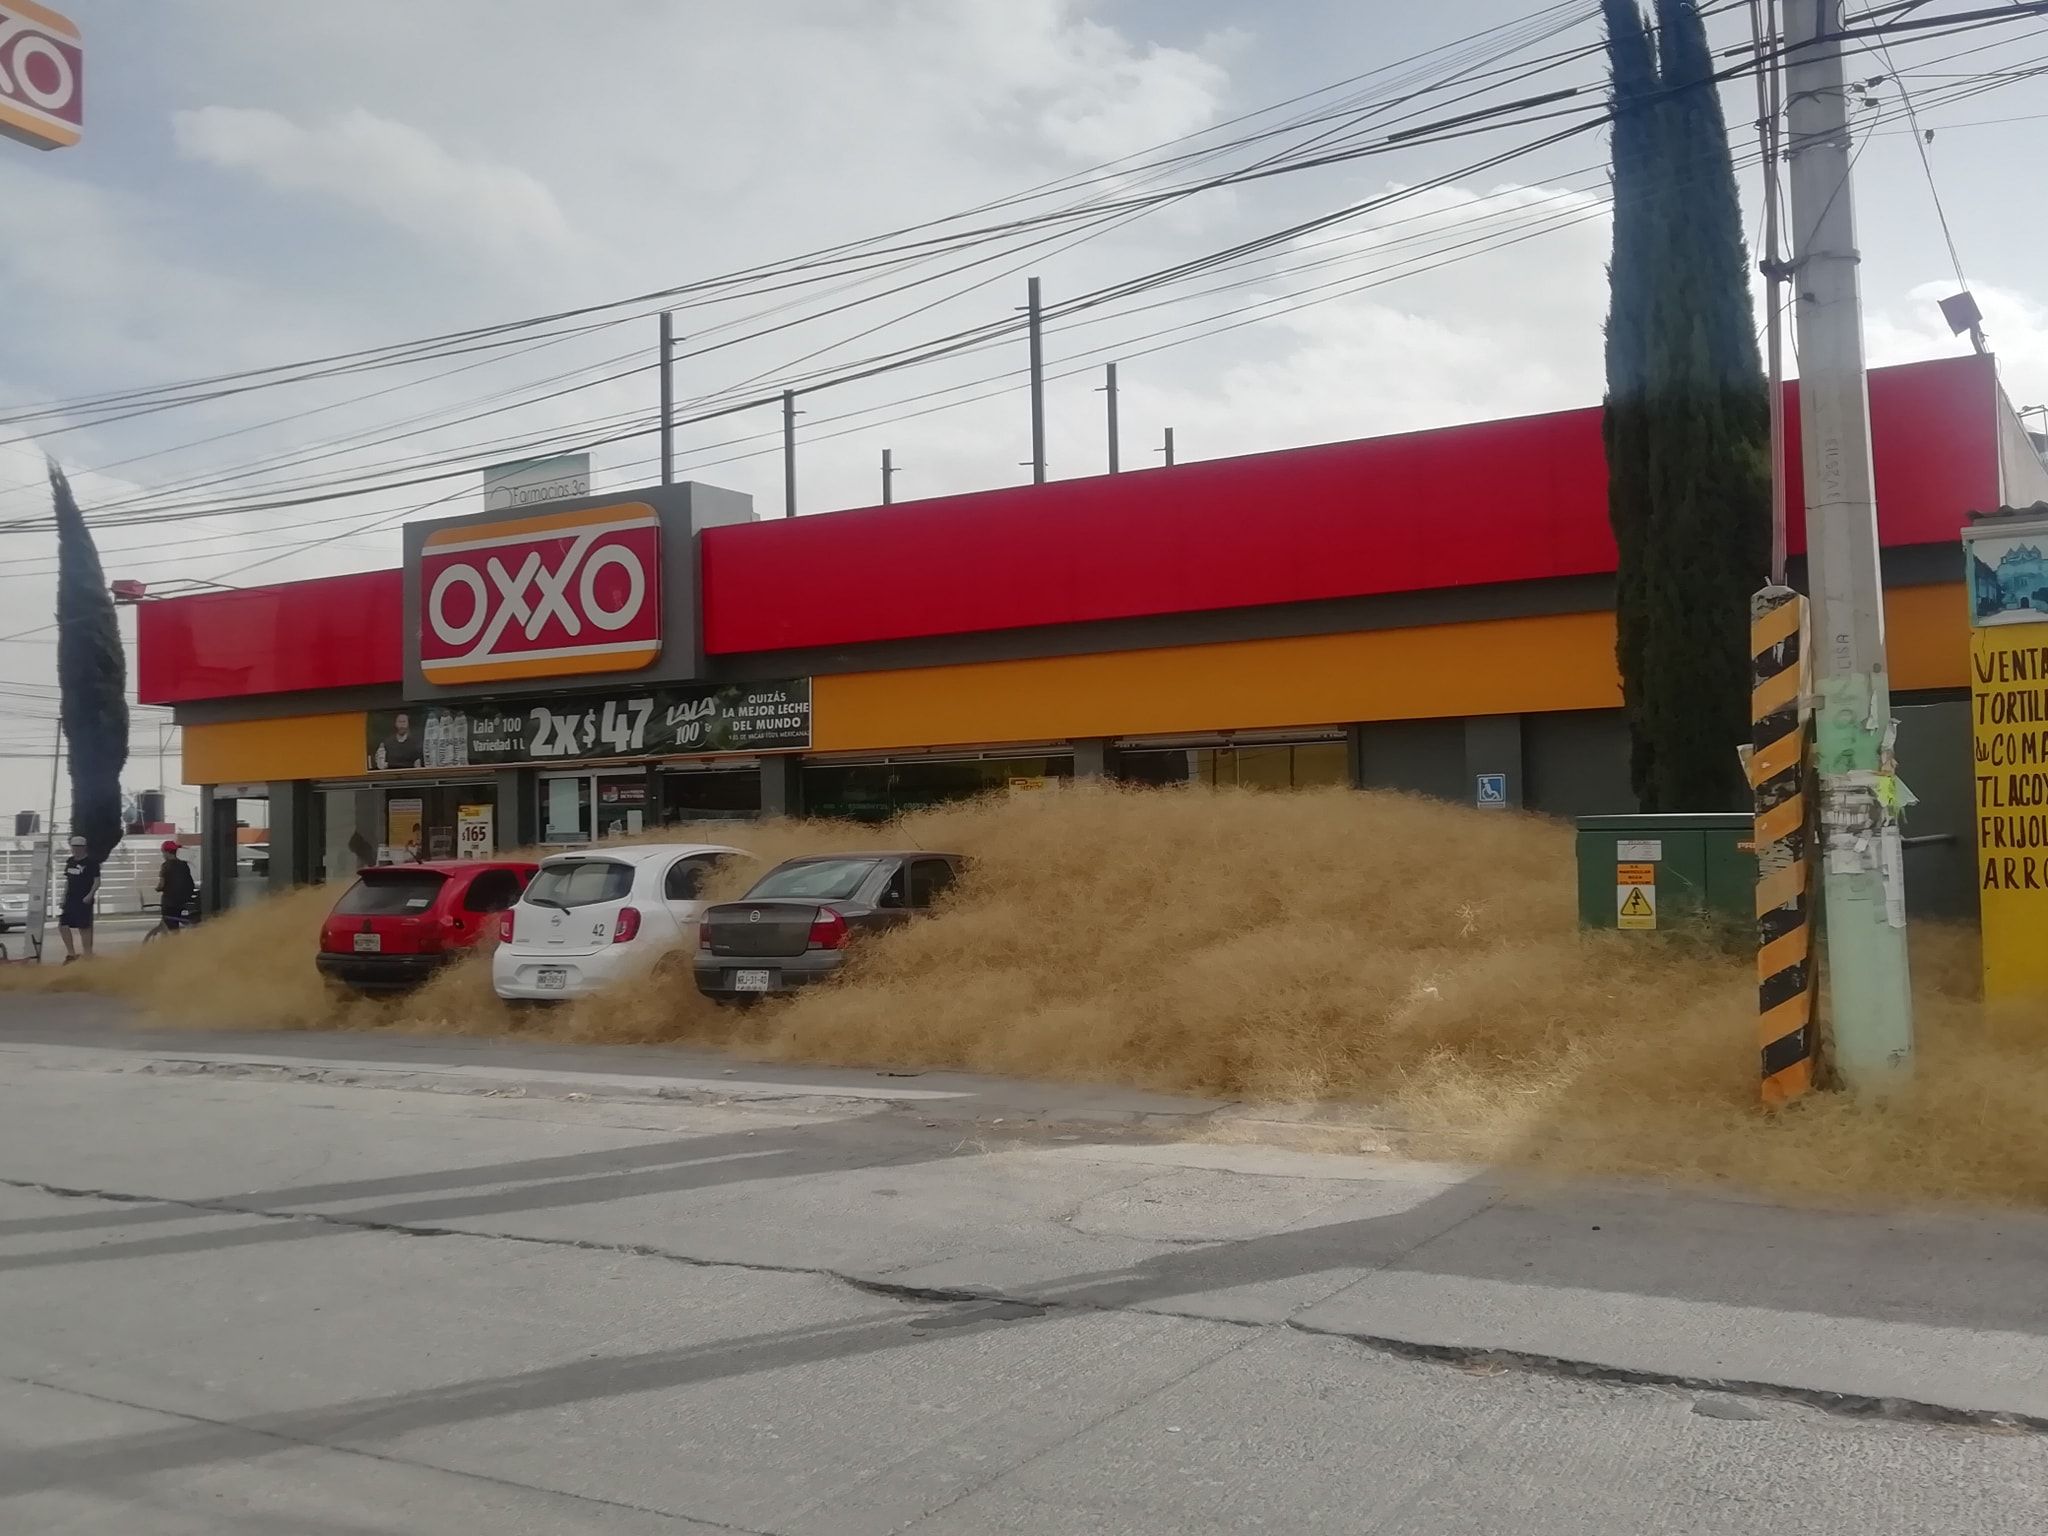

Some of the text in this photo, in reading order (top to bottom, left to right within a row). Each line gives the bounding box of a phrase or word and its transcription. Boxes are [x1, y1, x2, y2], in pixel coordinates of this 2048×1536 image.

[428, 545, 645, 655] OXXO
[748, 690, 787, 704] QUIZÁS
[722, 702, 810, 718] LA MEJOR LECHE
[502, 717, 522, 733] 100
[732, 717, 801, 731] DEL MUNDO
[675, 722, 699, 745] 100
[472, 738, 511, 752] Variedad
[462, 825, 487, 841] $165
[592, 923, 605, 937] 42
